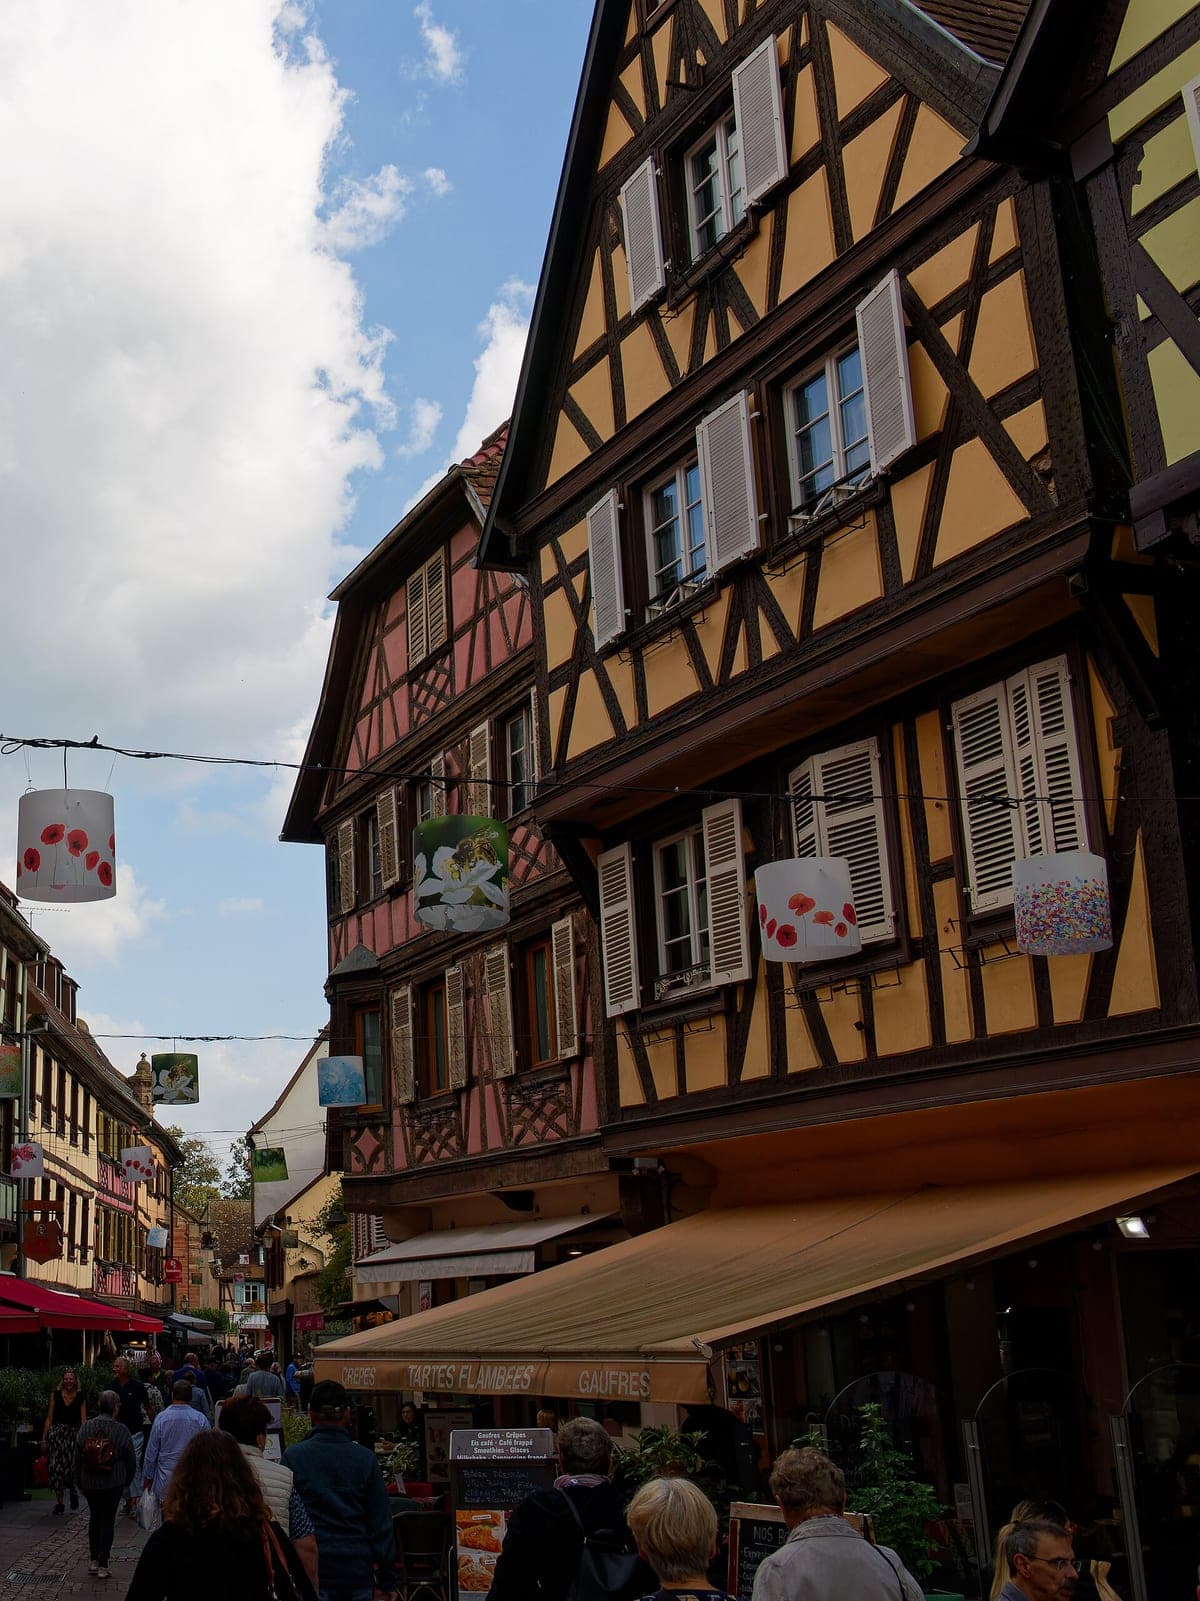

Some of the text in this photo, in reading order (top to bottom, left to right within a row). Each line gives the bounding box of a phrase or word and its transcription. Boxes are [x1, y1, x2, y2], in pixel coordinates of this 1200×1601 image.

[408, 1365, 456, 1389] TARTES
[579, 1370, 650, 1396] GAUFRES
[506, 1431, 526, 1439] Crêpes
[514, 1438, 533, 1447] frappé
[753, 1525, 773, 1542] NOS
